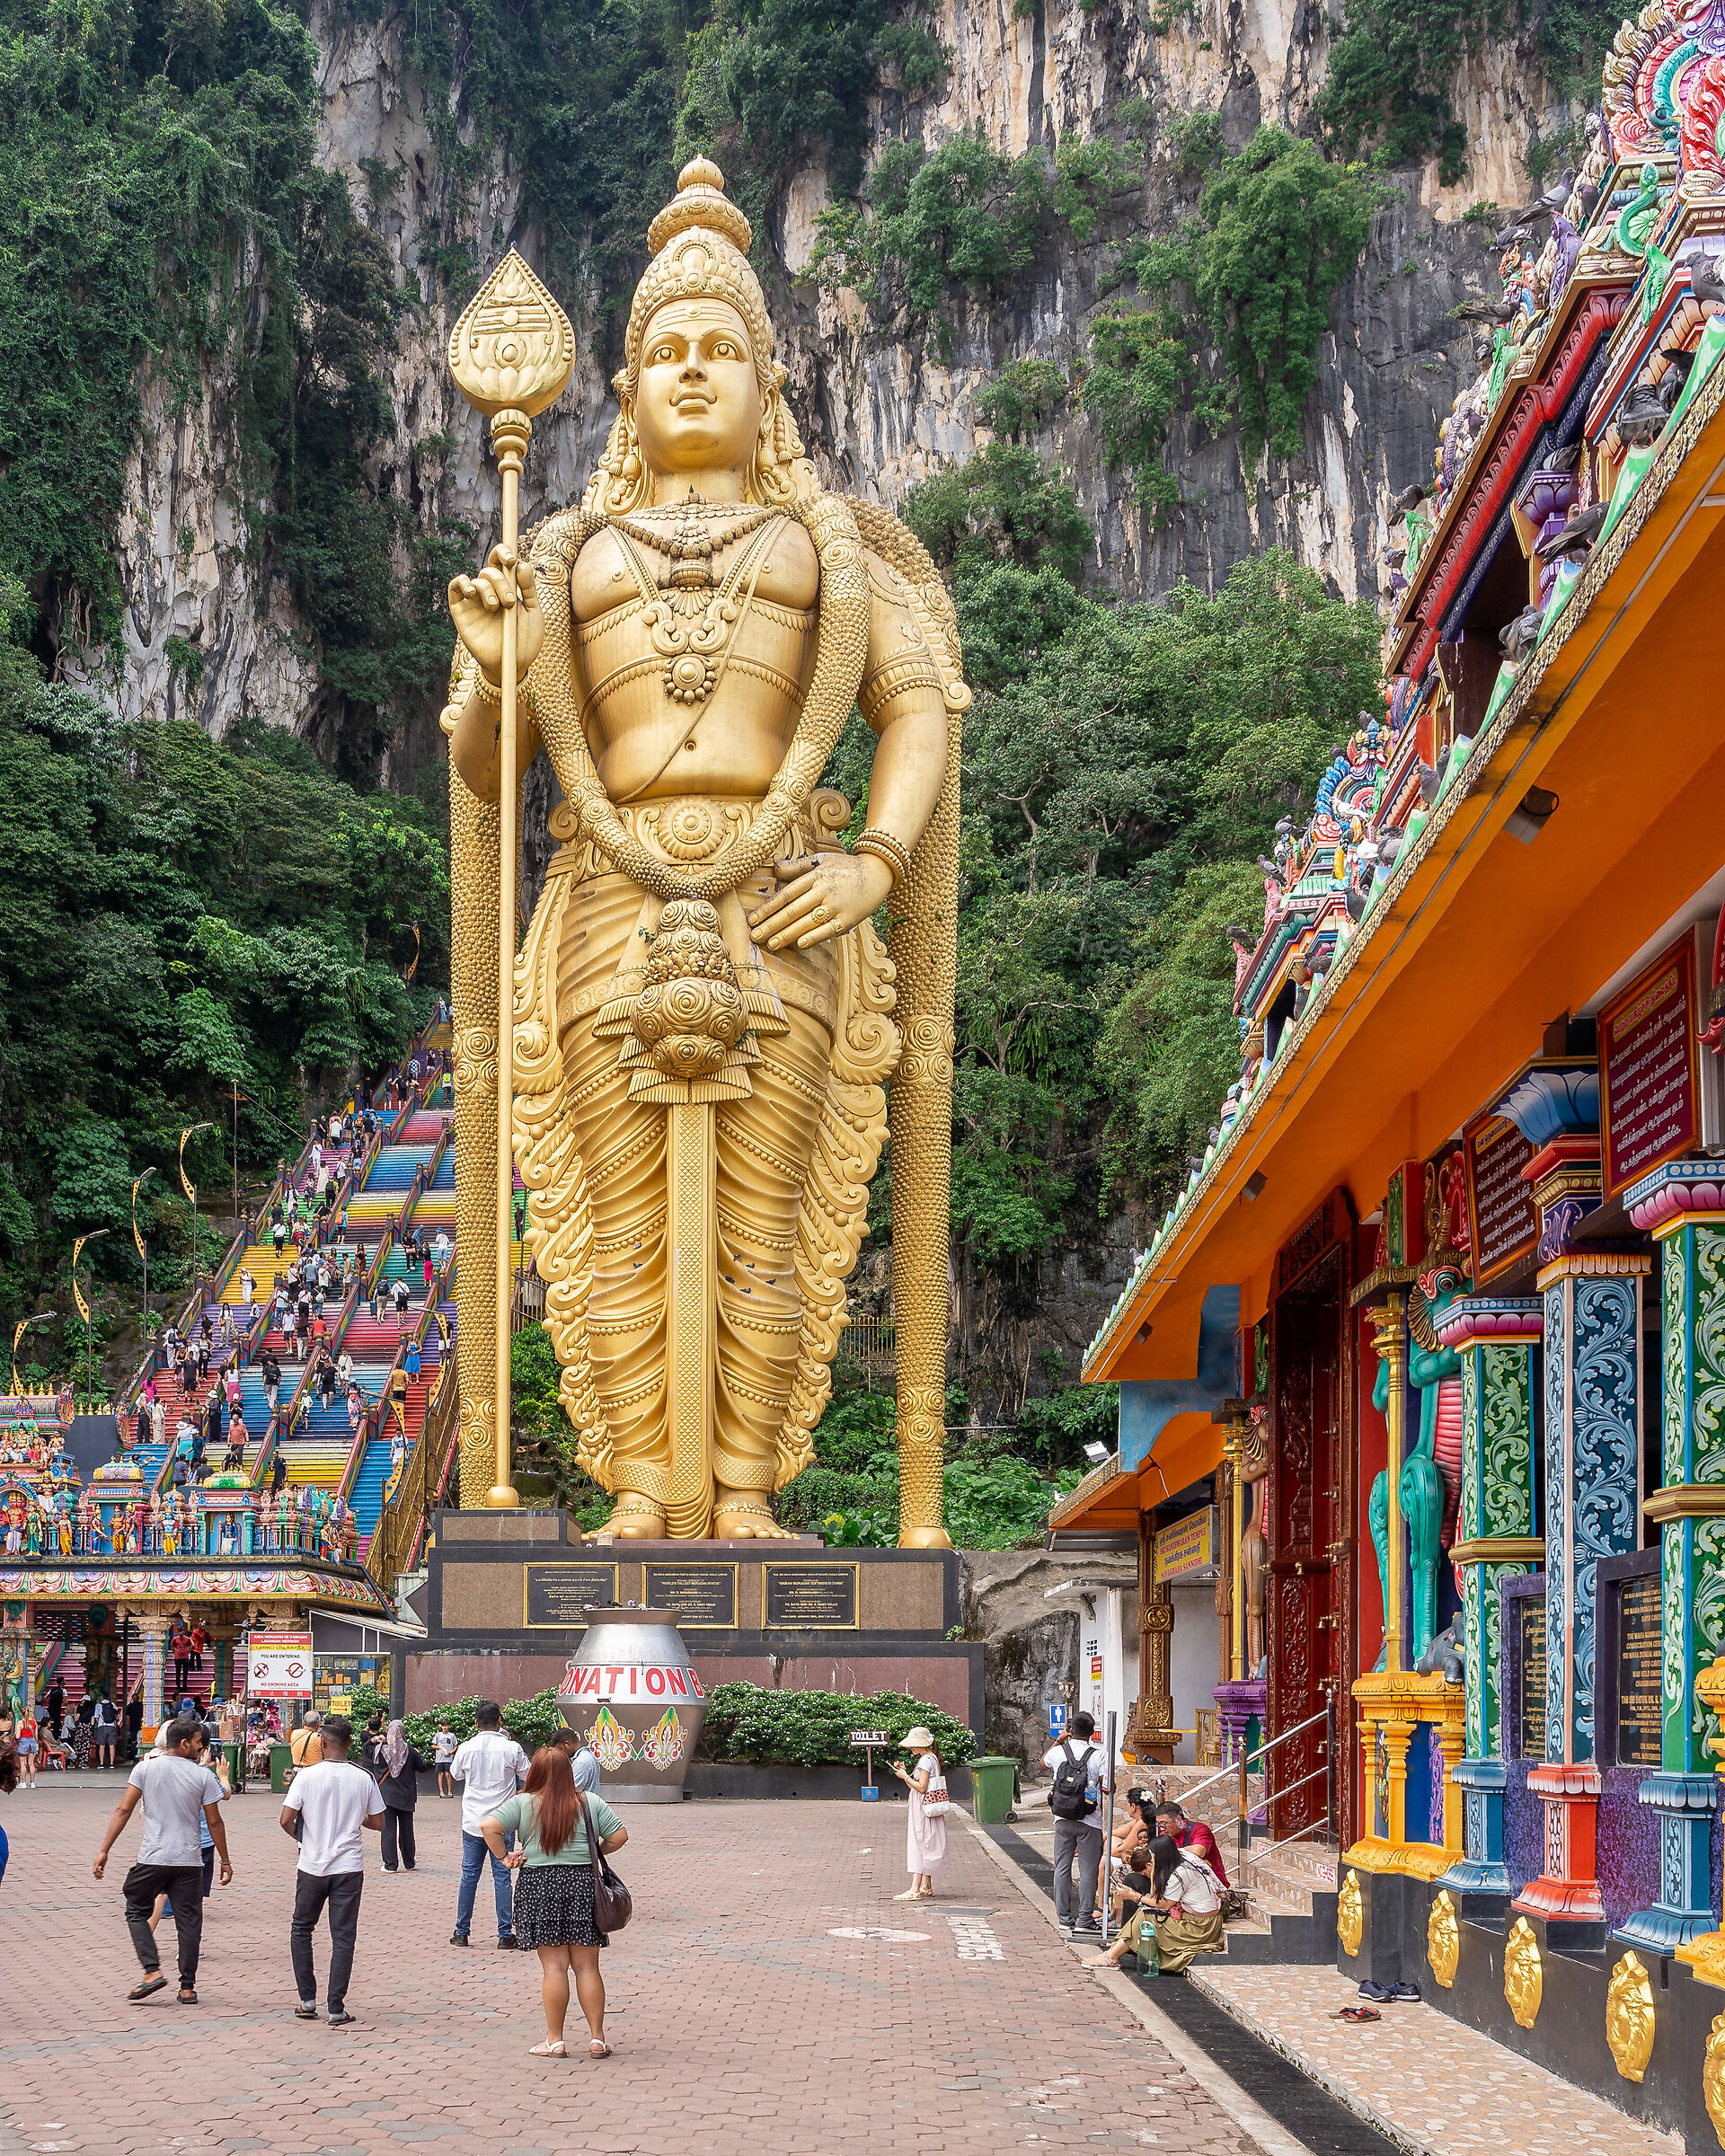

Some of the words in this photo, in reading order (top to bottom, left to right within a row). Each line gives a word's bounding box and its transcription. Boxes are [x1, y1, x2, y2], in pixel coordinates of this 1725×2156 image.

[1191, 1527, 1206, 1541] TEMPLE
[559, 1667, 688, 1697] ONATION
[688, 1669, 704, 1697] B
[850, 1731, 887, 1741] TOILET
